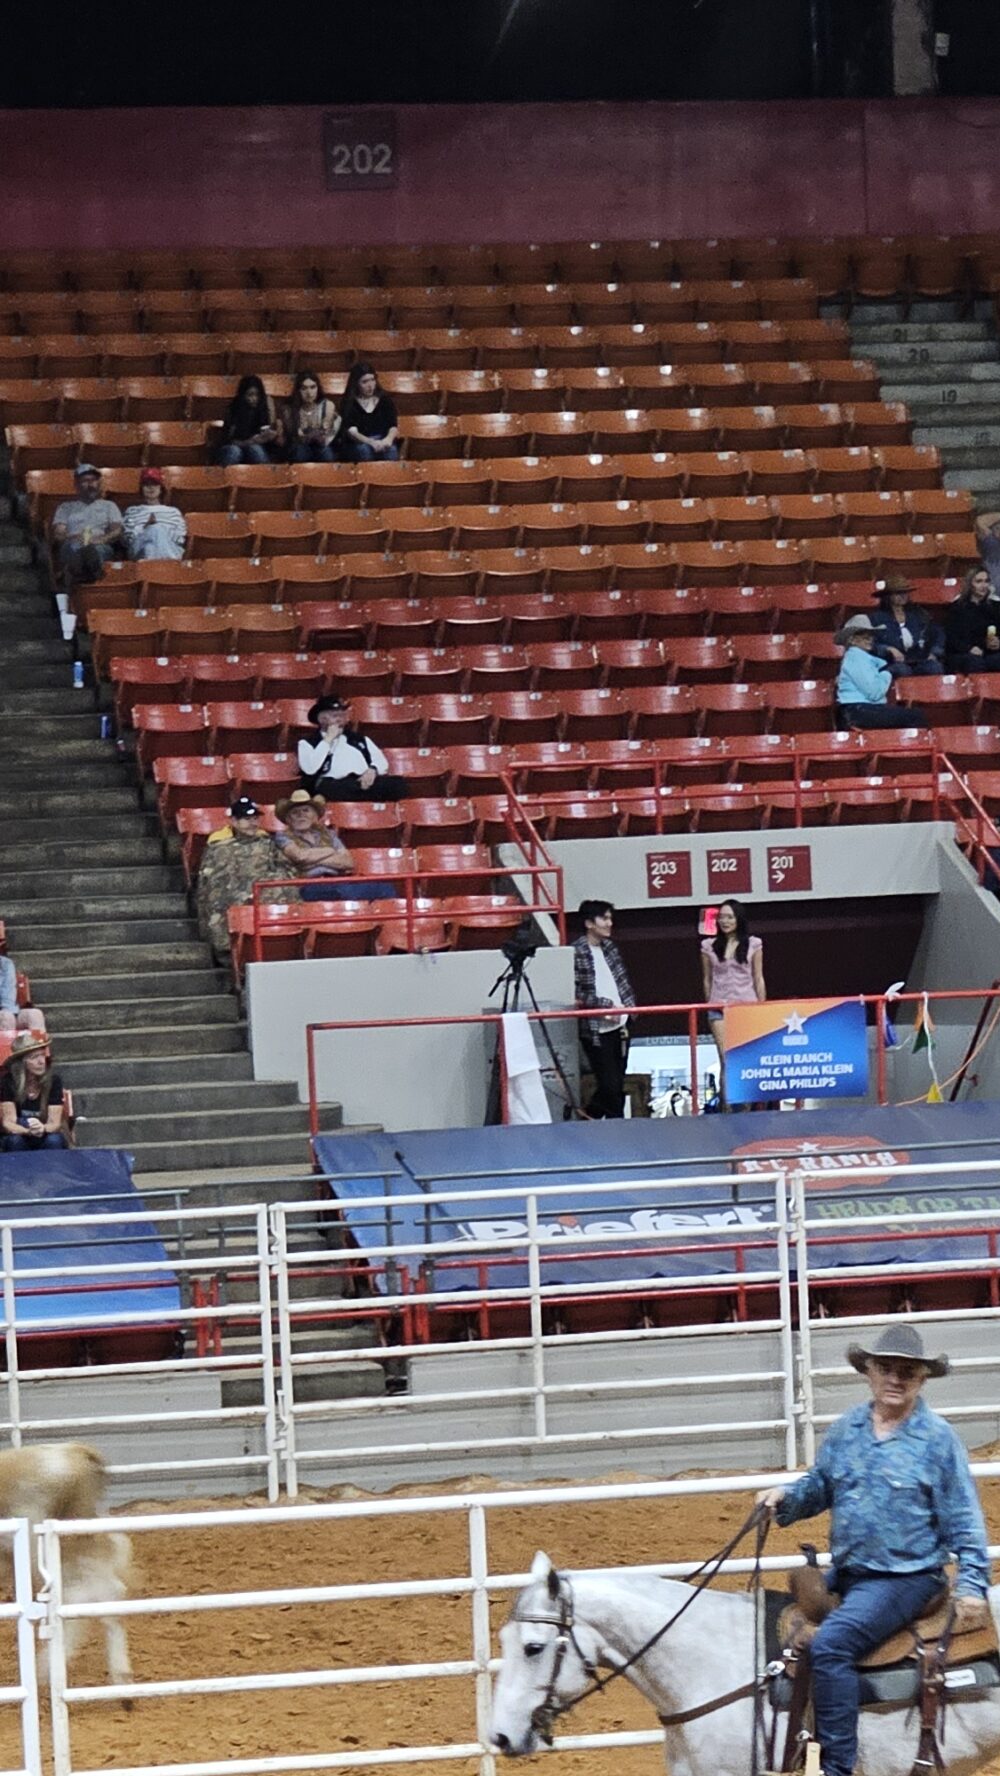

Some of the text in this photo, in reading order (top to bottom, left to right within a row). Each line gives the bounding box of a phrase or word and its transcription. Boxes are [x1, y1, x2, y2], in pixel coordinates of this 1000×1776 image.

[332, 143, 393, 175] 202
[651, 861, 677, 876] 203
[711, 858, 738, 873] 202
[771, 855, 794, 870] 201
[760, 1052, 833, 1066] KLEIN RANCH
[740, 1063, 853, 1080] JOHN & MARIA KLEIN
[759, 1077, 836, 1091] GINA PHILLIPS
[799, 1151, 898, 1171] RANCH
[468, 1206, 764, 1241] Priefert
